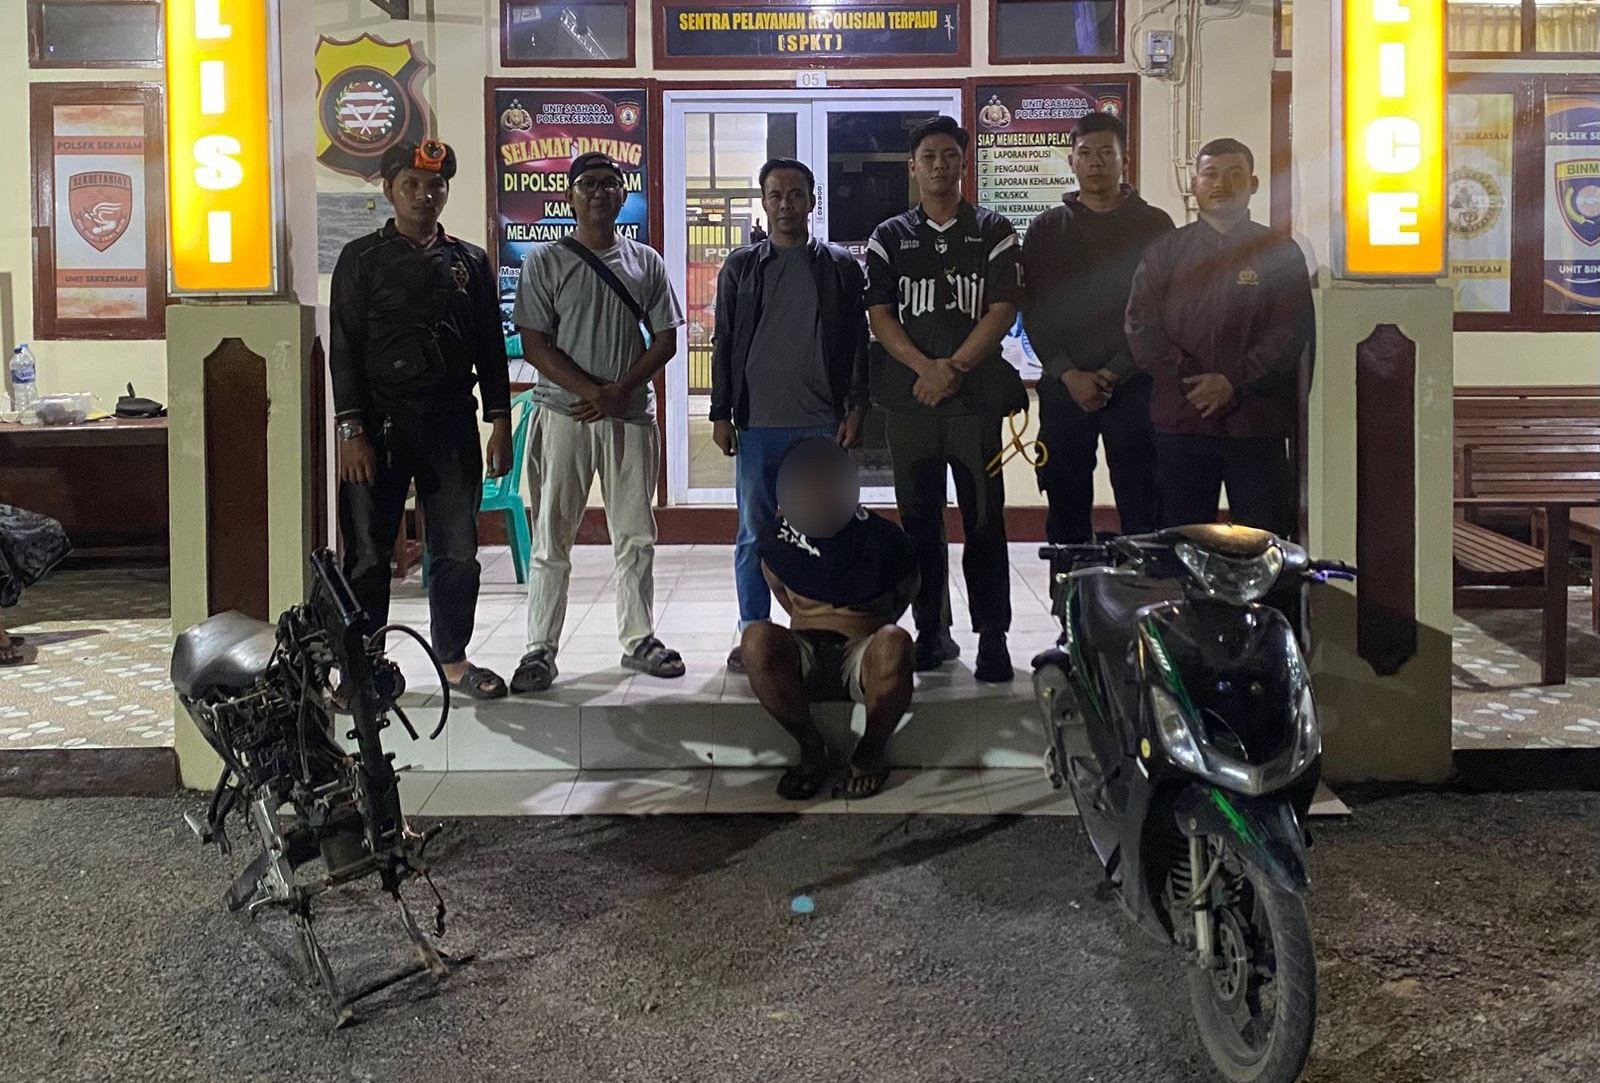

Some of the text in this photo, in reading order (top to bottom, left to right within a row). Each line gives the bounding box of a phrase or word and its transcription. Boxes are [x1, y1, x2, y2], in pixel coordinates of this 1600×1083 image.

[679, 10, 938, 30] SENTRA PELAYANAN KEPOLISIAN TERPADU
[801, 72, 820, 87] 05
[1022, 99, 1088, 108] UNIT SABHARA
[542, 104, 608, 114] UNIT SABHARA
[1015, 109, 1050, 119] POLSEK
[536, 114, 615, 124] POLSEK SEKAYAM
[978, 132, 1072, 146] SIAP MEMBERIKAN PELAY
[1550, 132, 1588, 141] POLSEK
[57, 141, 94, 150] POLSEK
[501, 137, 642, 166] SELAMAT DATANG
[994, 149, 1051, 159] LAPORAN POLISI
[994, 165, 1039, 173] PENGADUAN
[504, 173, 518, 192] DI
[994, 176, 1075, 186] LAPORAN KEHILANGAN
[994, 191, 1028, 200] RCK/SKCK
[544, 201, 573, 217] KAM
[507, 225, 562, 240] MELAYANI
[1559, 265, 1582, 274] UNIT
